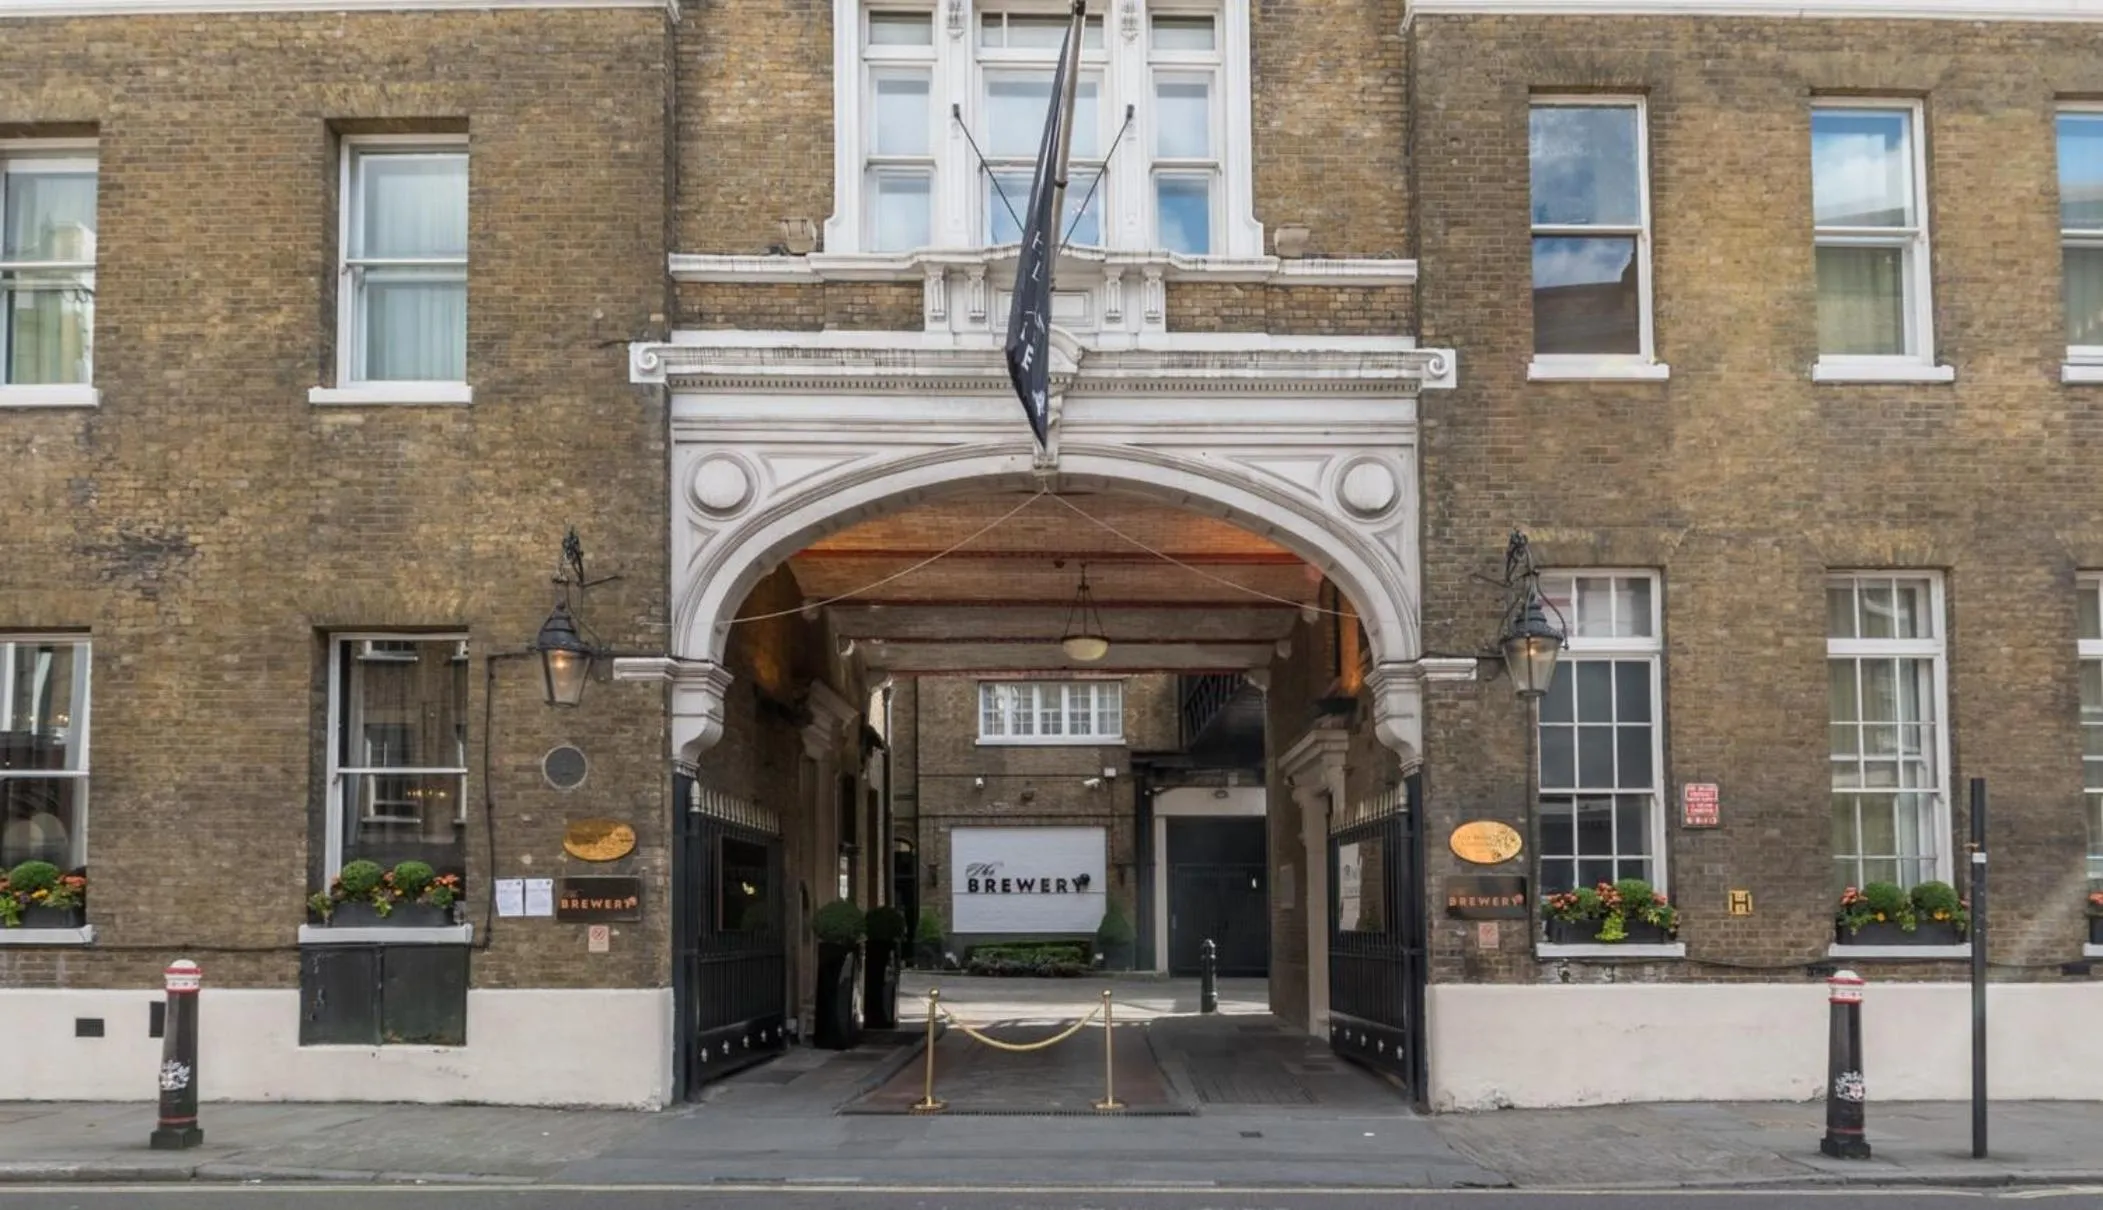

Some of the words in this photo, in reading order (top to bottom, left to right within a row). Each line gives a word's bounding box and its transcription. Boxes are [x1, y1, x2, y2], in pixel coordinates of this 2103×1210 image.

[968, 878, 1084, 893] BREWERY
[561, 898, 632, 909] BREWERY
[1448, 896, 1518, 907] BREWERY
[1732, 893, 1749, 912] H
